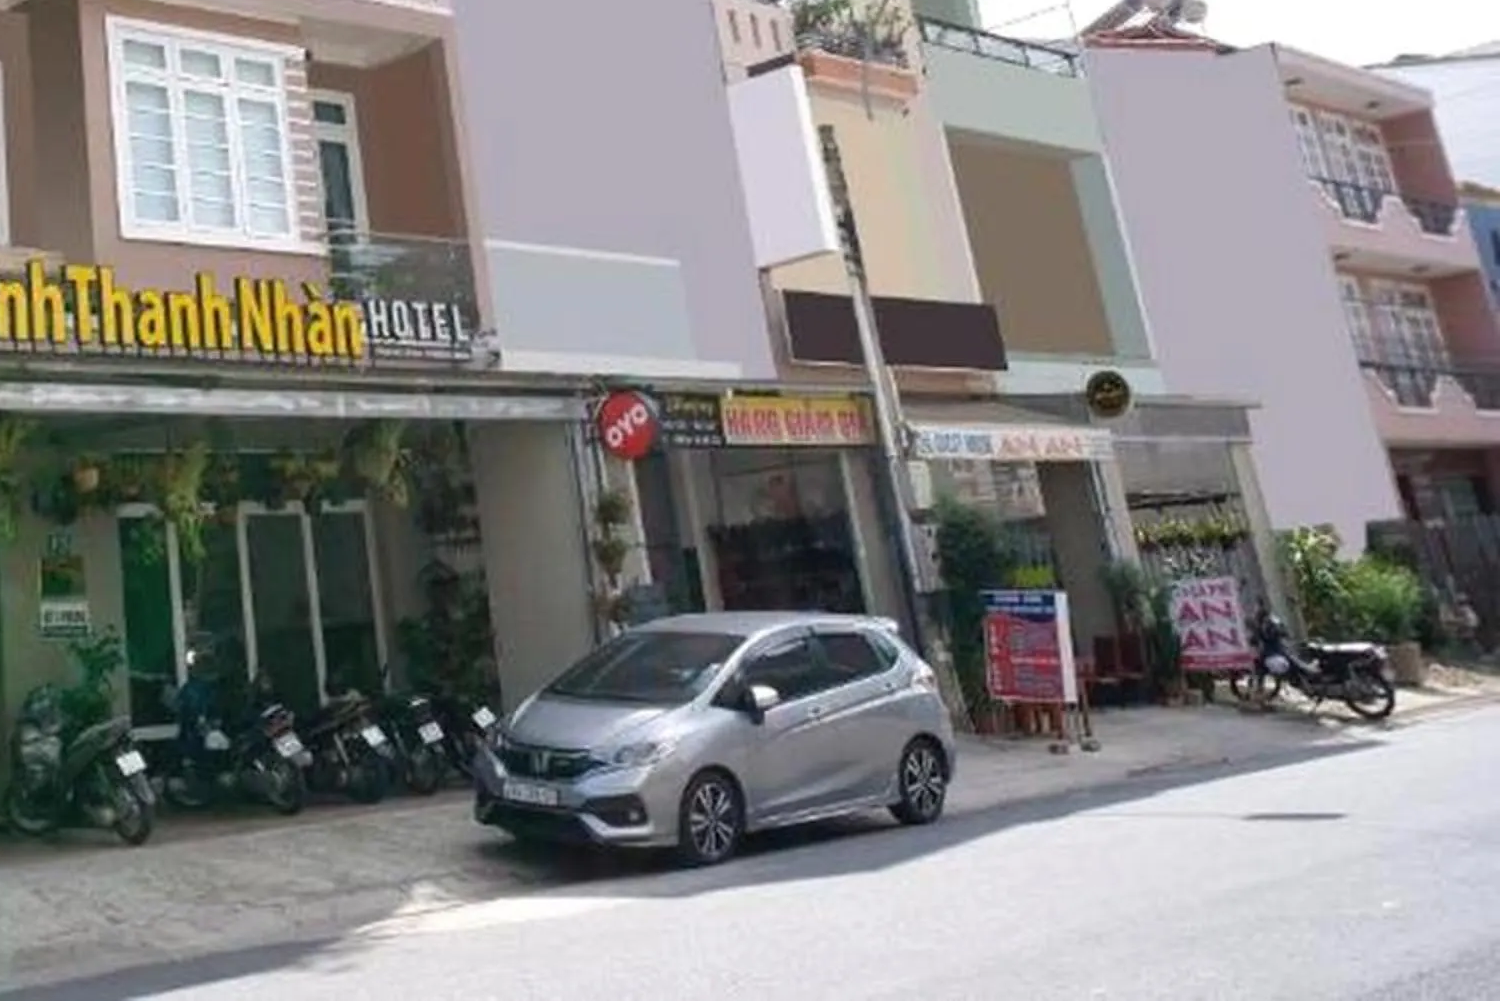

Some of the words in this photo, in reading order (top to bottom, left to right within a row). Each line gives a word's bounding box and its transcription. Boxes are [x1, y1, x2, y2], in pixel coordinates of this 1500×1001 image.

[62, 263, 234, 350] Thanh
[234, 276, 363, 359] Nhàn
[366, 298, 470, 341] HOTEL
[604, 401, 649, 449] OYO
[1180, 599, 1233, 621] AN
[1184, 627, 1242, 649] AN
